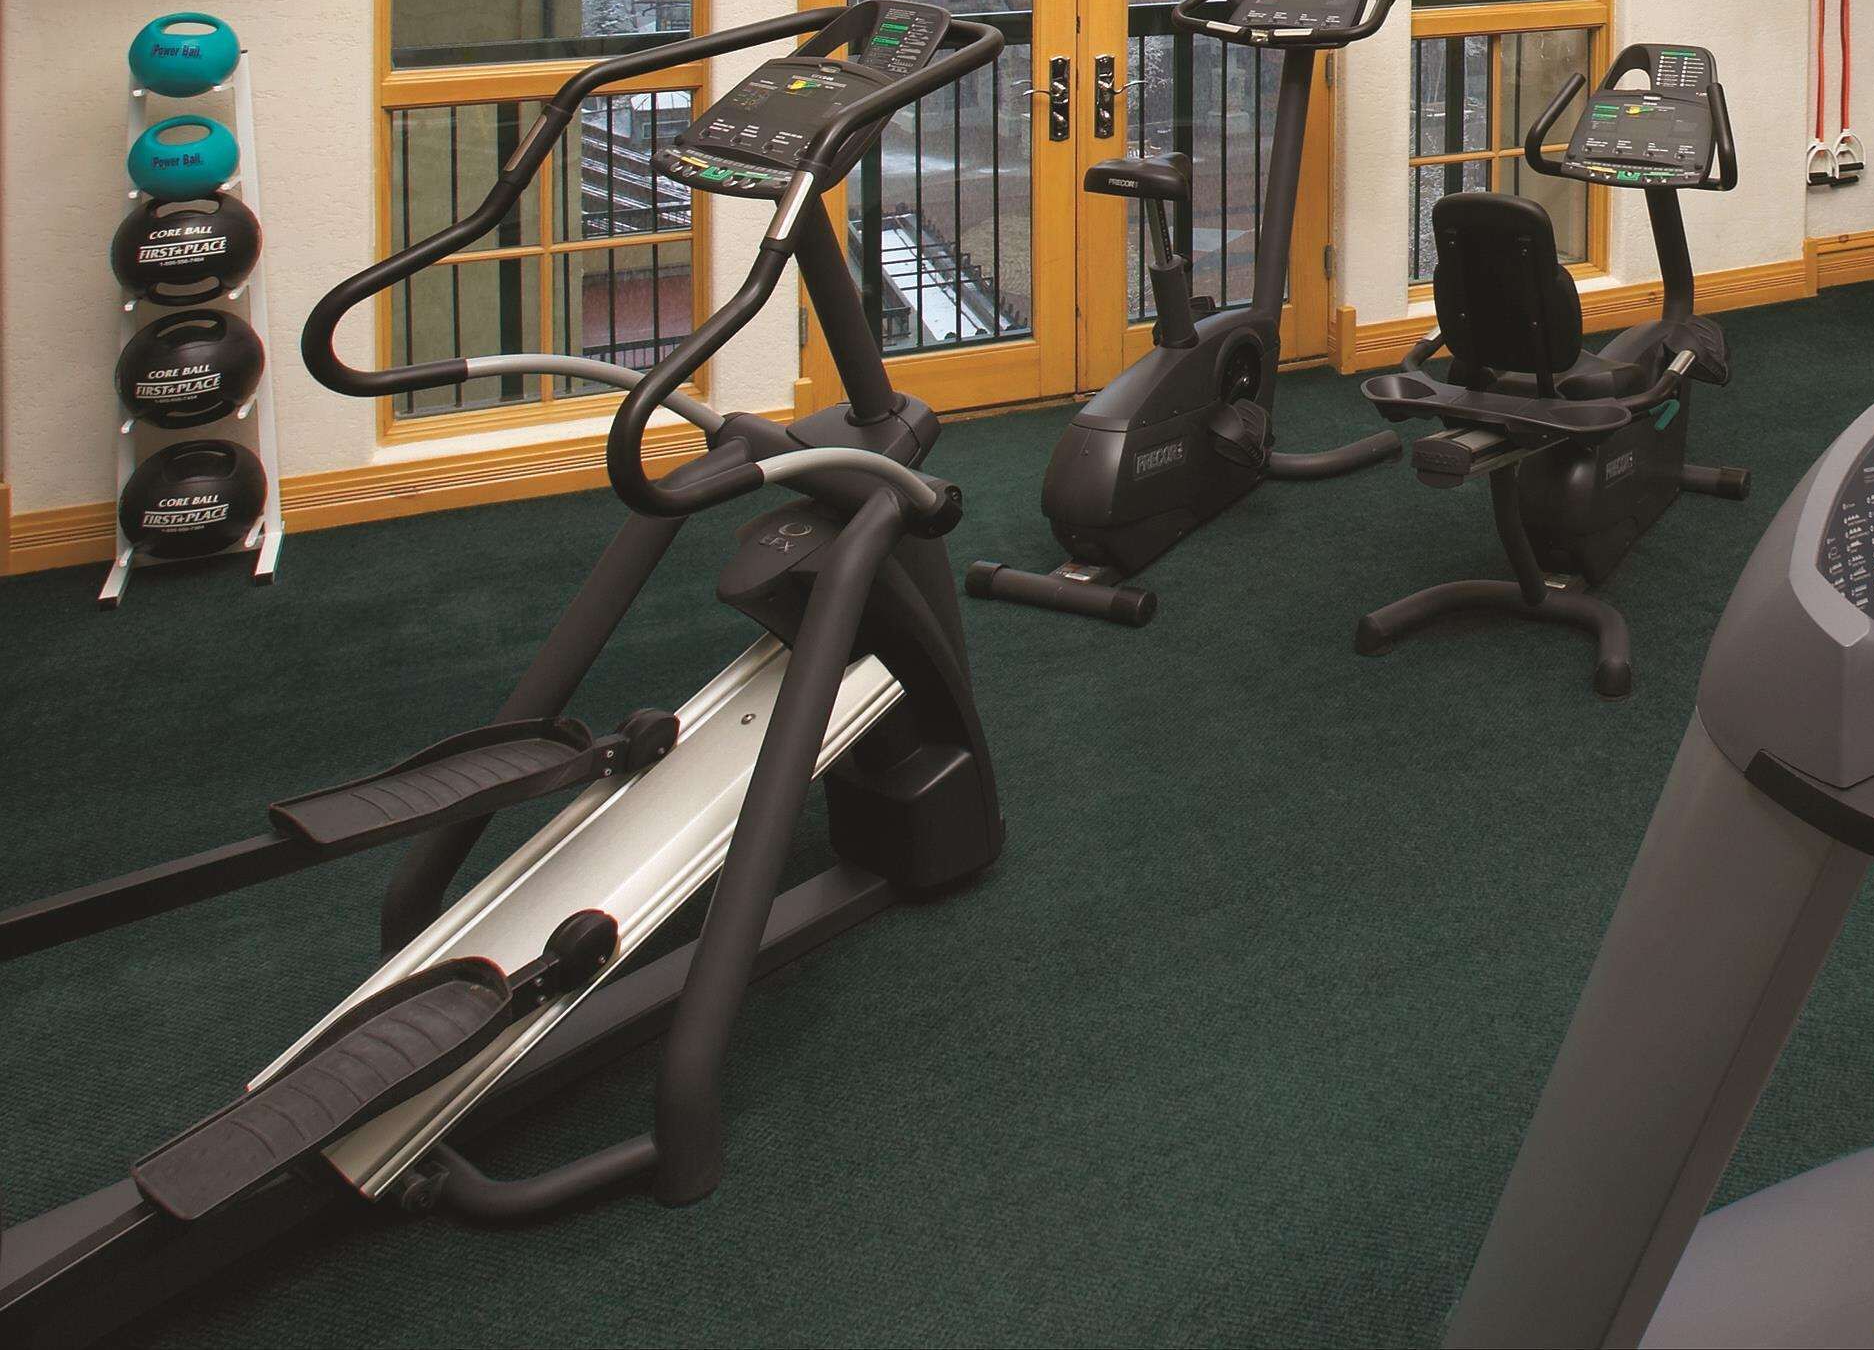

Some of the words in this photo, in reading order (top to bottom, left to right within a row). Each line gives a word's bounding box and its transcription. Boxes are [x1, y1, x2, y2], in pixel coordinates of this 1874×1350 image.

[152, 44, 180, 58] Power
[152, 155, 180, 169] Power
[149, 228, 182, 240] CORE
[184, 226, 213, 235] BALL
[148, 368, 179, 380] CORE
[182, 364, 210, 376] BALL
[159, 497, 190, 508] CORE
[192, 494, 219, 505] BALL
